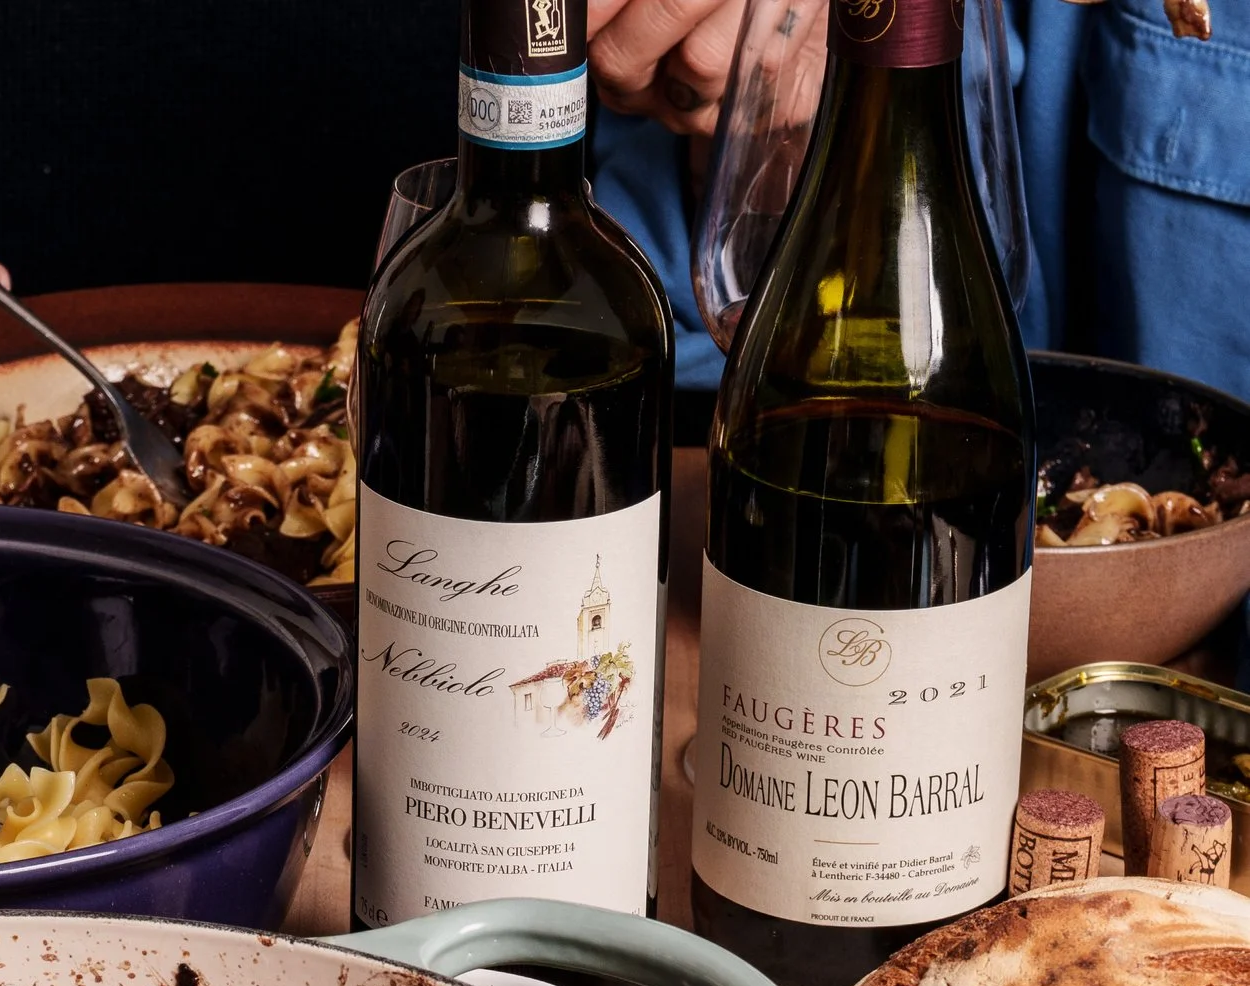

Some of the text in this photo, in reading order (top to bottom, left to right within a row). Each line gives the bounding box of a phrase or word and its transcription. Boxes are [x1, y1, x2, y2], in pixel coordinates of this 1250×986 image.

[531, 39, 564, 47] VIGNAIOLI
[470, 97, 496, 122] DOC
[377, 539, 522, 602] Langhe
[365, 588, 540, 638] DENOMINAZIONE DI ORIGINE CONTROLLATA
[361, 641, 506, 698] Nebbiolo
[722, 684, 886, 740] FAUGÈRES
[398, 720, 443, 743] 2024
[721, 714, 885, 756] Appellation Faugères Contrôlée
[721, 725, 826, 764] RED FAUGÈRES WINE
[410, 777, 585, 803] IMBOTTIGLIATO ALL'ORIGINE DA
[405, 795, 597, 831] PIERO BENEVELLI
[425, 836, 576, 857] LOCALITÀ SAN GIUSEPPE 14
[757, 846, 778, 865] 750ml
[424, 854, 485, 874] MONFORTE
[486, 863, 528, 875] D'ALBA
[537, 860, 574, 874] ITALIA
[811, 869, 817, 878] à
[819, 871, 864, 881] Lentheric
[865, 871, 900, 881] F-34480
[908, 863, 955, 878] Cabrerolles
[812, 851, 954, 872] Élevé et vinifié par Didier Barral
[809, 888, 841, 902] Mis
[860, 887, 913, 904] bouteille
[914, 890, 931, 899] au
[933, 876, 980, 897] Domaine
[810, 913, 839, 922] PRODUIT
[850, 915, 875, 923] FRANCE
